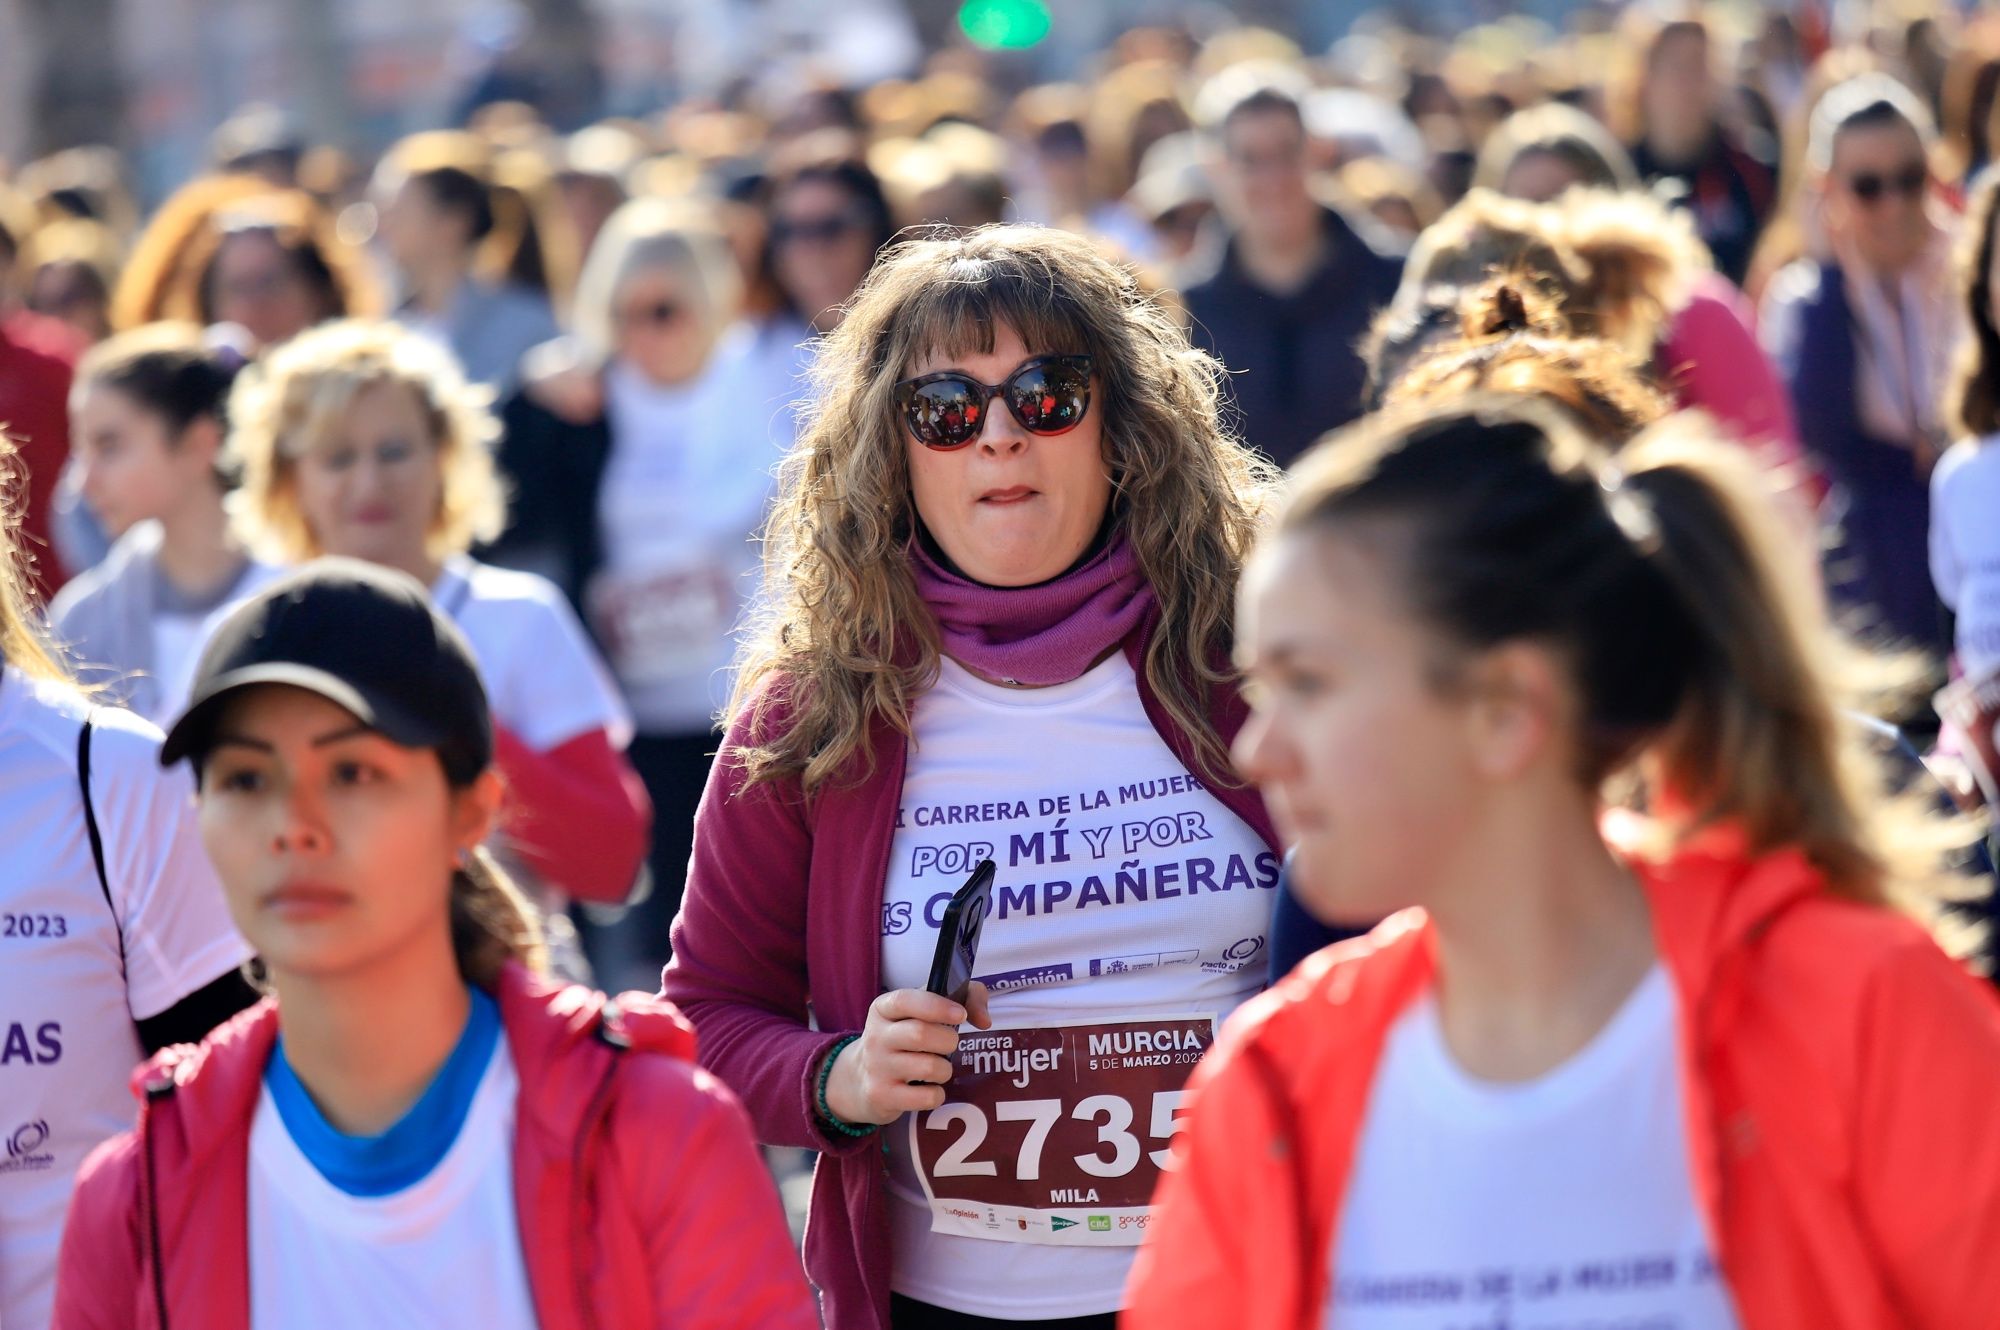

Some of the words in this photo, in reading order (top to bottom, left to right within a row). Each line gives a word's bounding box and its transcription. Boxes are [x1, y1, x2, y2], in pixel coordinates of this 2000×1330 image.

[914, 801, 1030, 827] CARRERA
[1039, 795, 1071, 816] DE
[1080, 790, 1111, 811] LA
[1119, 774, 1204, 804] MUJER
[911, 842, 997, 877] POR
[1009, 818, 1070, 866] MÍ
[1080, 826, 1113, 859] Y
[1122, 811, 1214, 854] POR
[923, 851, 1280, 929] CMPAÑERAS
[3, 914, 67, 938] 2023
[0, 1021, 62, 1065] AS
[958, 1036, 1013, 1052] carrera
[1088, 1029, 1202, 1056] MURCIA
[1089, 1059, 1098, 1070] 5
[1102, 1058, 1119, 1069] DE
[1122, 1054, 1171, 1068] MARZO
[1174, 1052, 1206, 1064] 2023
[974, 1047, 1063, 1089] mujer
[925, 1089, 1198, 1181] 2735
[1050, 1188, 1100, 1203] MILA
